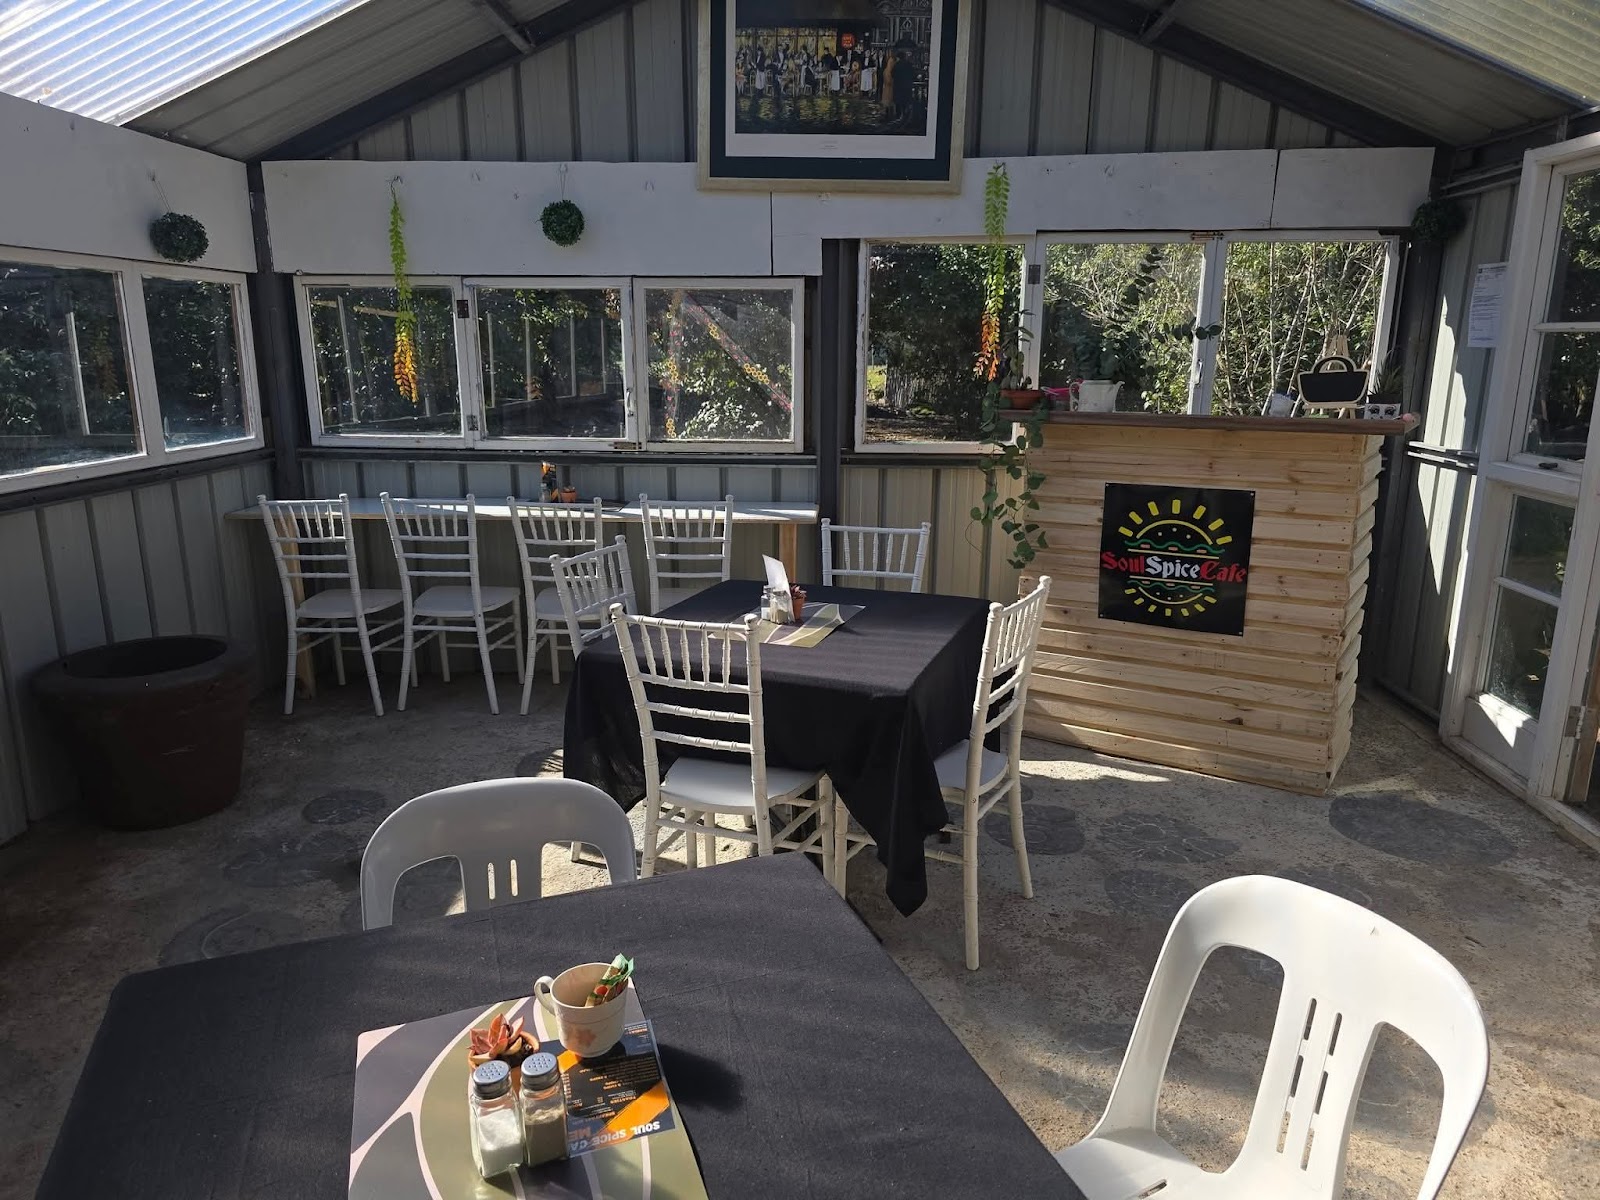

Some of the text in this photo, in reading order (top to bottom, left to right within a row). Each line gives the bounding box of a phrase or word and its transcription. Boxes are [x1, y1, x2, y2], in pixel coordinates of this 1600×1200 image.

[1101, 551, 1247, 583] Soul Spice Cafe
[570, 1121, 660, 1151] SOUL SPICE CA
